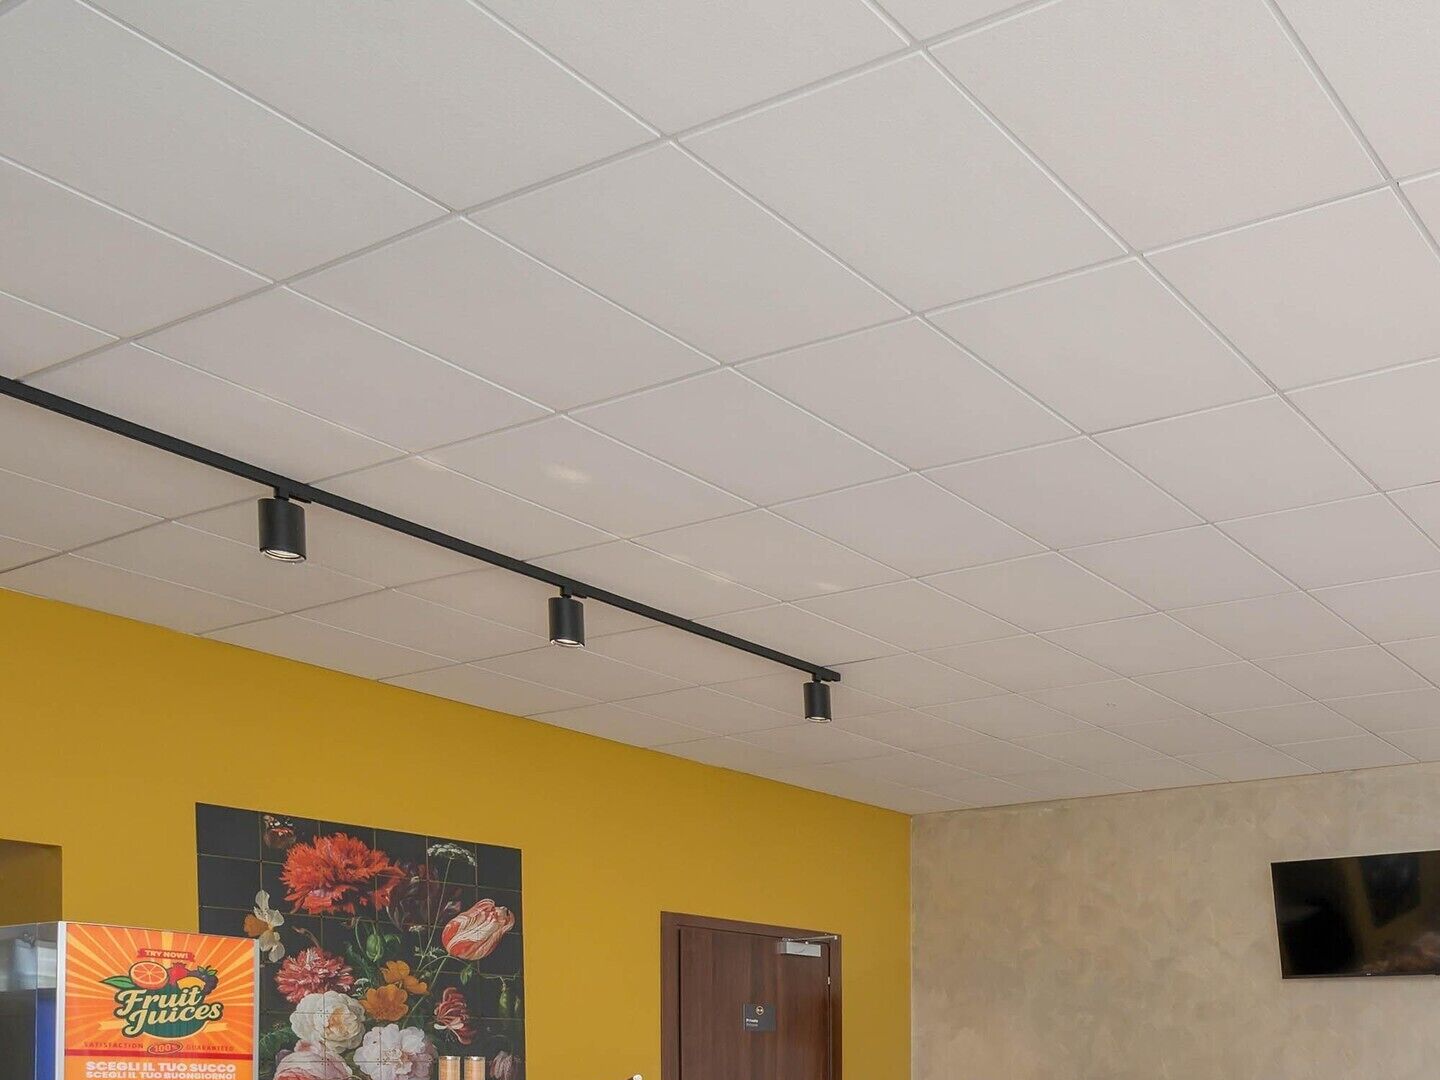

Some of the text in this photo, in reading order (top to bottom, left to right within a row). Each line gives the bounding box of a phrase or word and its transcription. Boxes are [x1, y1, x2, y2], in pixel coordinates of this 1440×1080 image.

[145, 949, 190, 960] TRY NOW!
[116, 986, 203, 1016] Fruit
[124, 1003, 222, 1036] Juices
[84, 1041, 144, 1049] SATISFACTION
[86, 1061, 236, 1073] SCEGLI IL TUO SUCCO
[86, 1071, 236, 1080] SCEGLI IL TUO BUONGIORNO!
